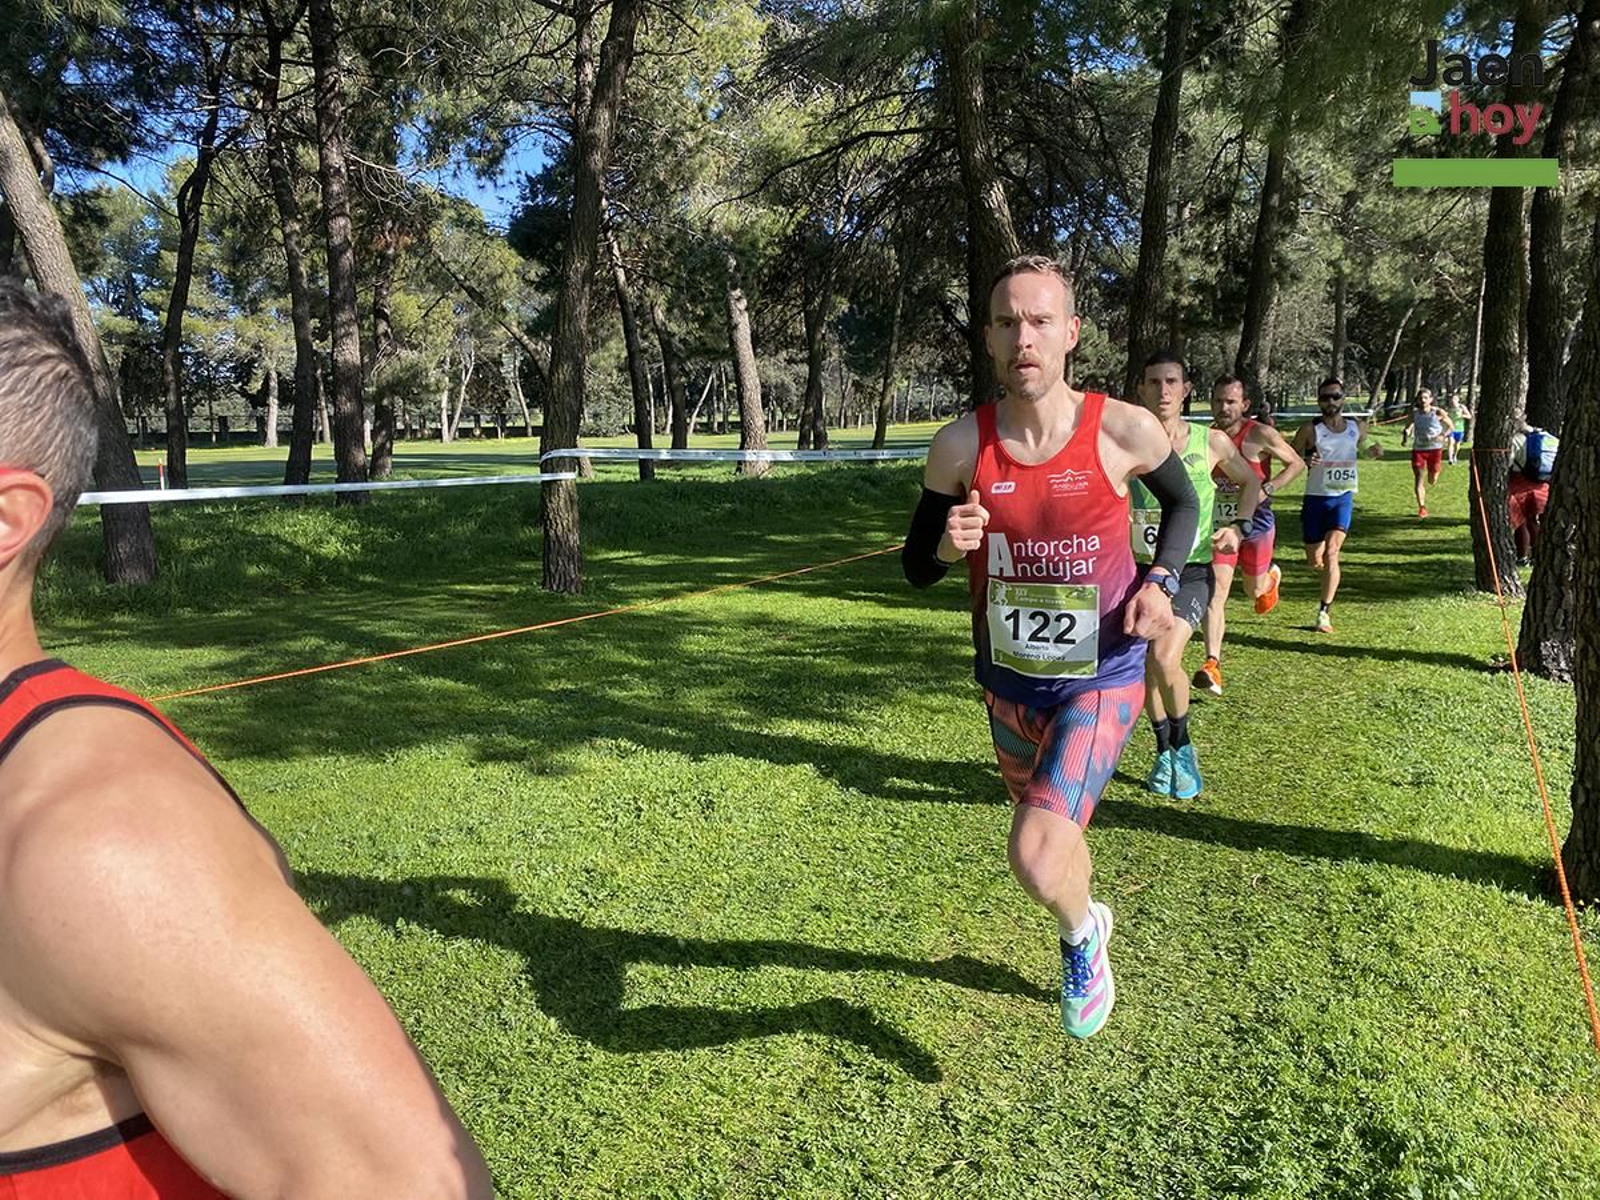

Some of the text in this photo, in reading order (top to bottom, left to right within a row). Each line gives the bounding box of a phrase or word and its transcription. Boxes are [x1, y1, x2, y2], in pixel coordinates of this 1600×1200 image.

[1326, 469, 1356, 481] 1054
[988, 533, 1100, 563] Antorcha
[1004, 609, 1077, 644] 122
[1025, 643, 1050, 651] Alberto
